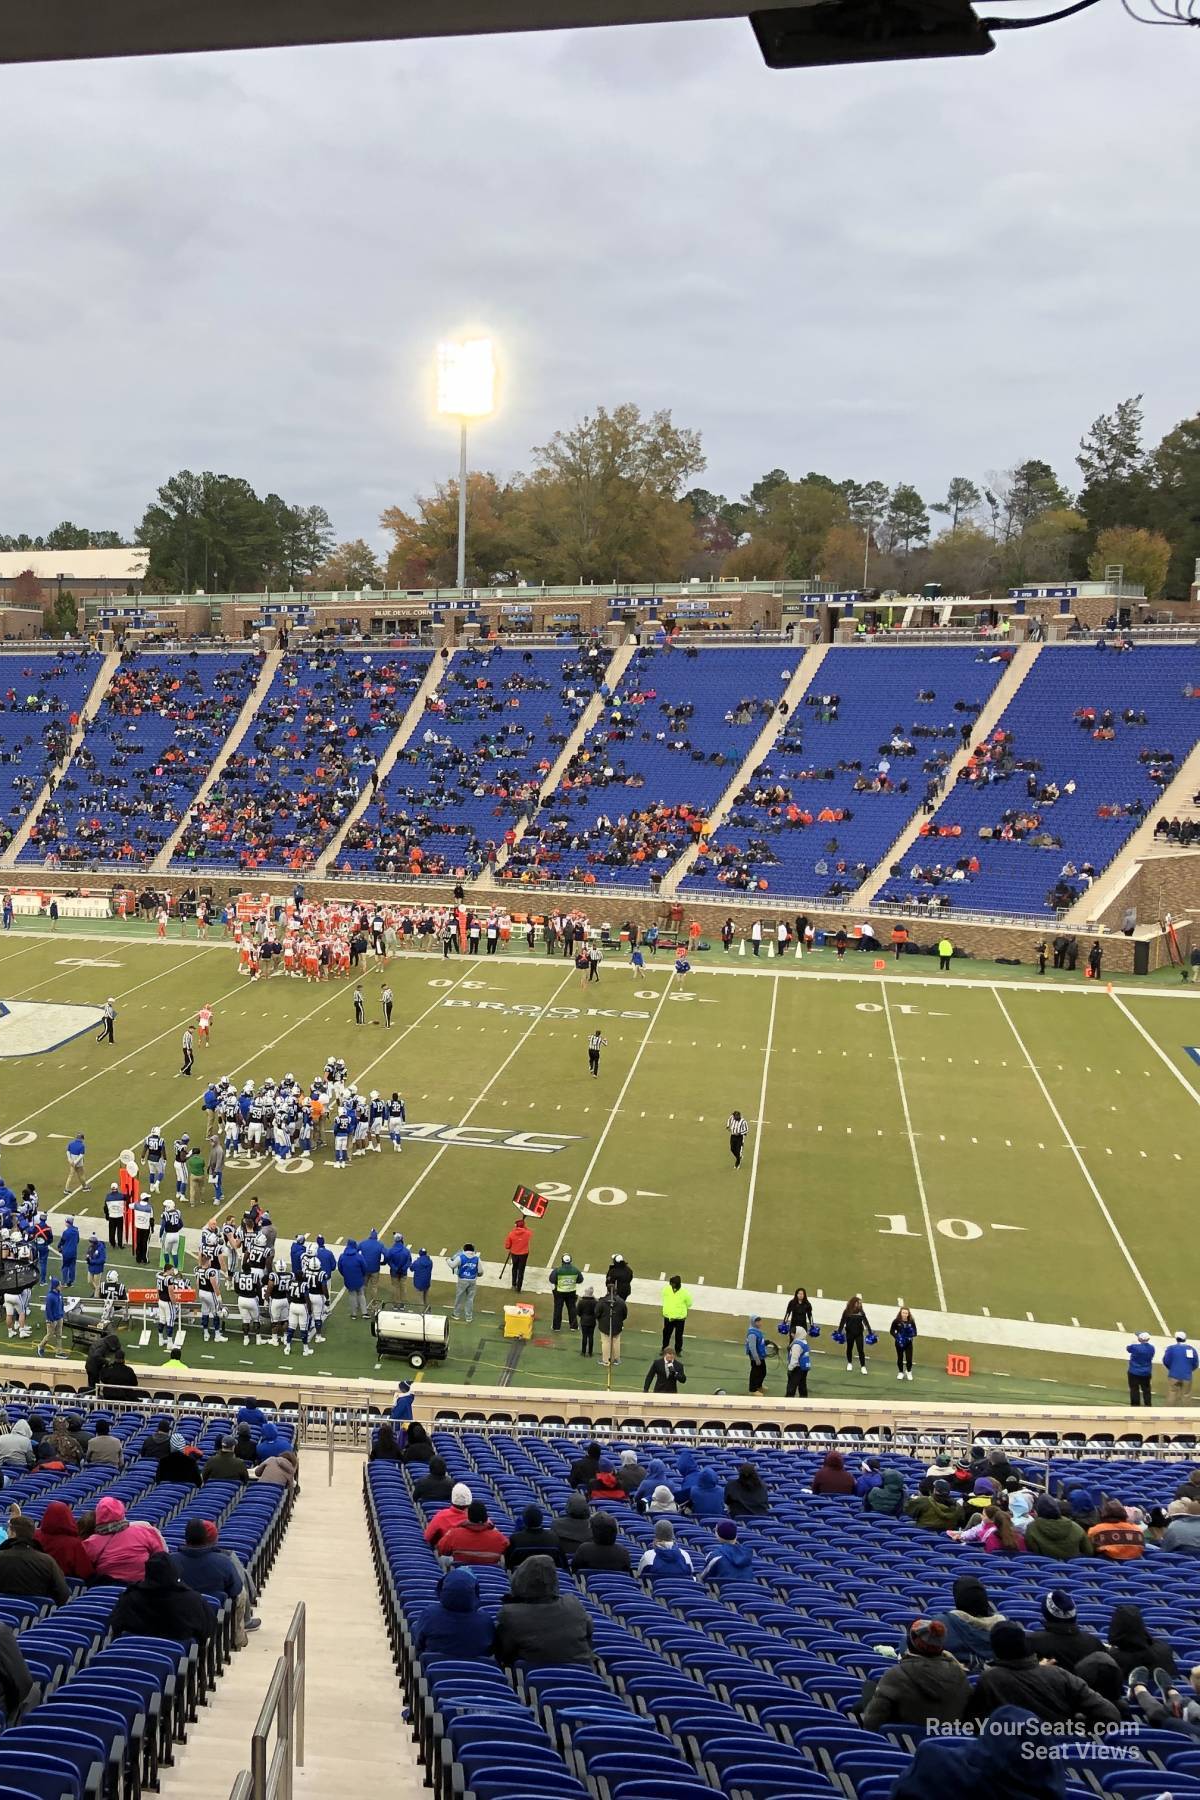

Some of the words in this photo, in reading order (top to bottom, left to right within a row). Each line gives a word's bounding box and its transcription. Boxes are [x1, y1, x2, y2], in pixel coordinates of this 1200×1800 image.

[427, 978, 489, 991] 30
[633, 989, 698, 1002] 20
[441, 998, 651, 1020] BROOKS
[500, 1010, 580, 1020] FIELD
[855, 1003, 921, 1014] 10
[385, 1122, 587, 1154] ACC
[535, 1182, 628, 1206] 20
[875, 1213, 984, 1240] 10
[249, 1250, 263, 1263] 67
[238, 1277, 253, 1291] 68
[306, 1274, 317, 1288] 71
[290, 1286, 300, 1298] 74
[950, 1357, 967, 1374] 10
